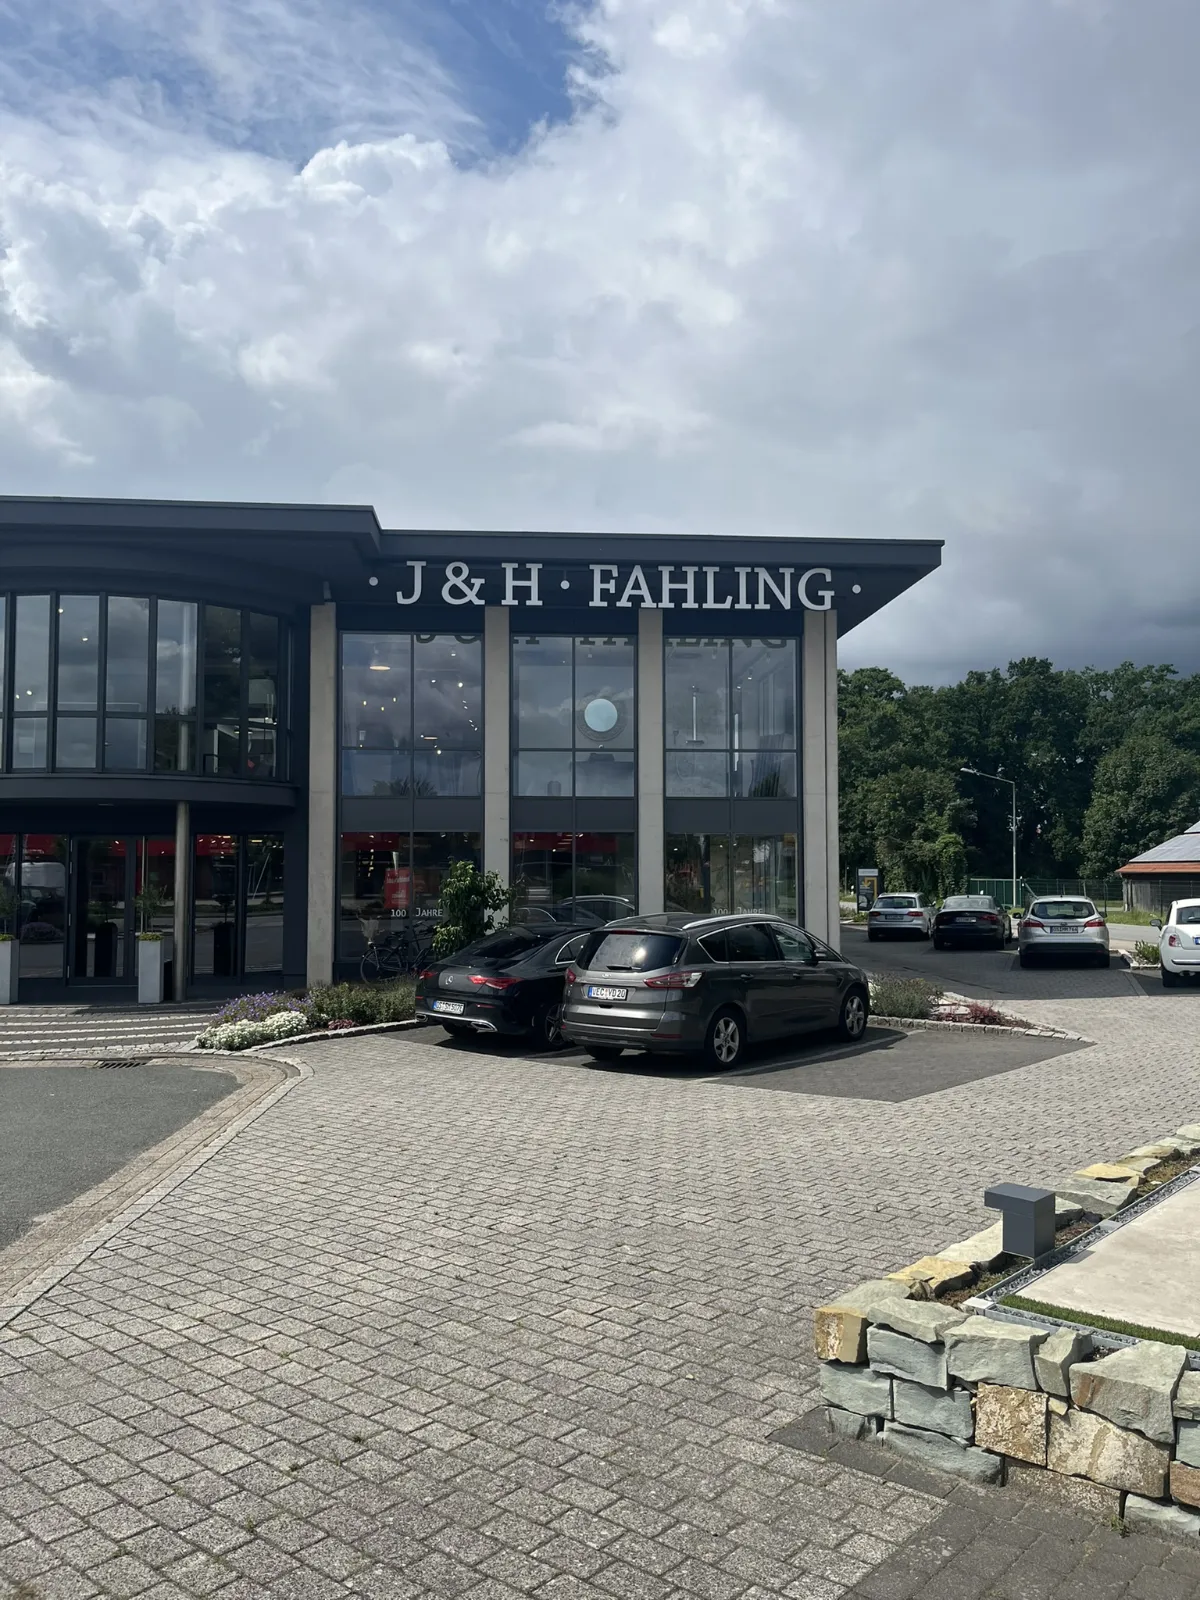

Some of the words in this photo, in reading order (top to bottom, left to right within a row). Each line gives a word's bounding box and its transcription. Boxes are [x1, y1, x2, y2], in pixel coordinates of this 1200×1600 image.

[396, 561, 427, 605] J
[441, 561, 486, 605] &
[501, 562, 543, 606] H
[588, 564, 836, 611] FAHLING
[391, 909, 407, 918] 100
